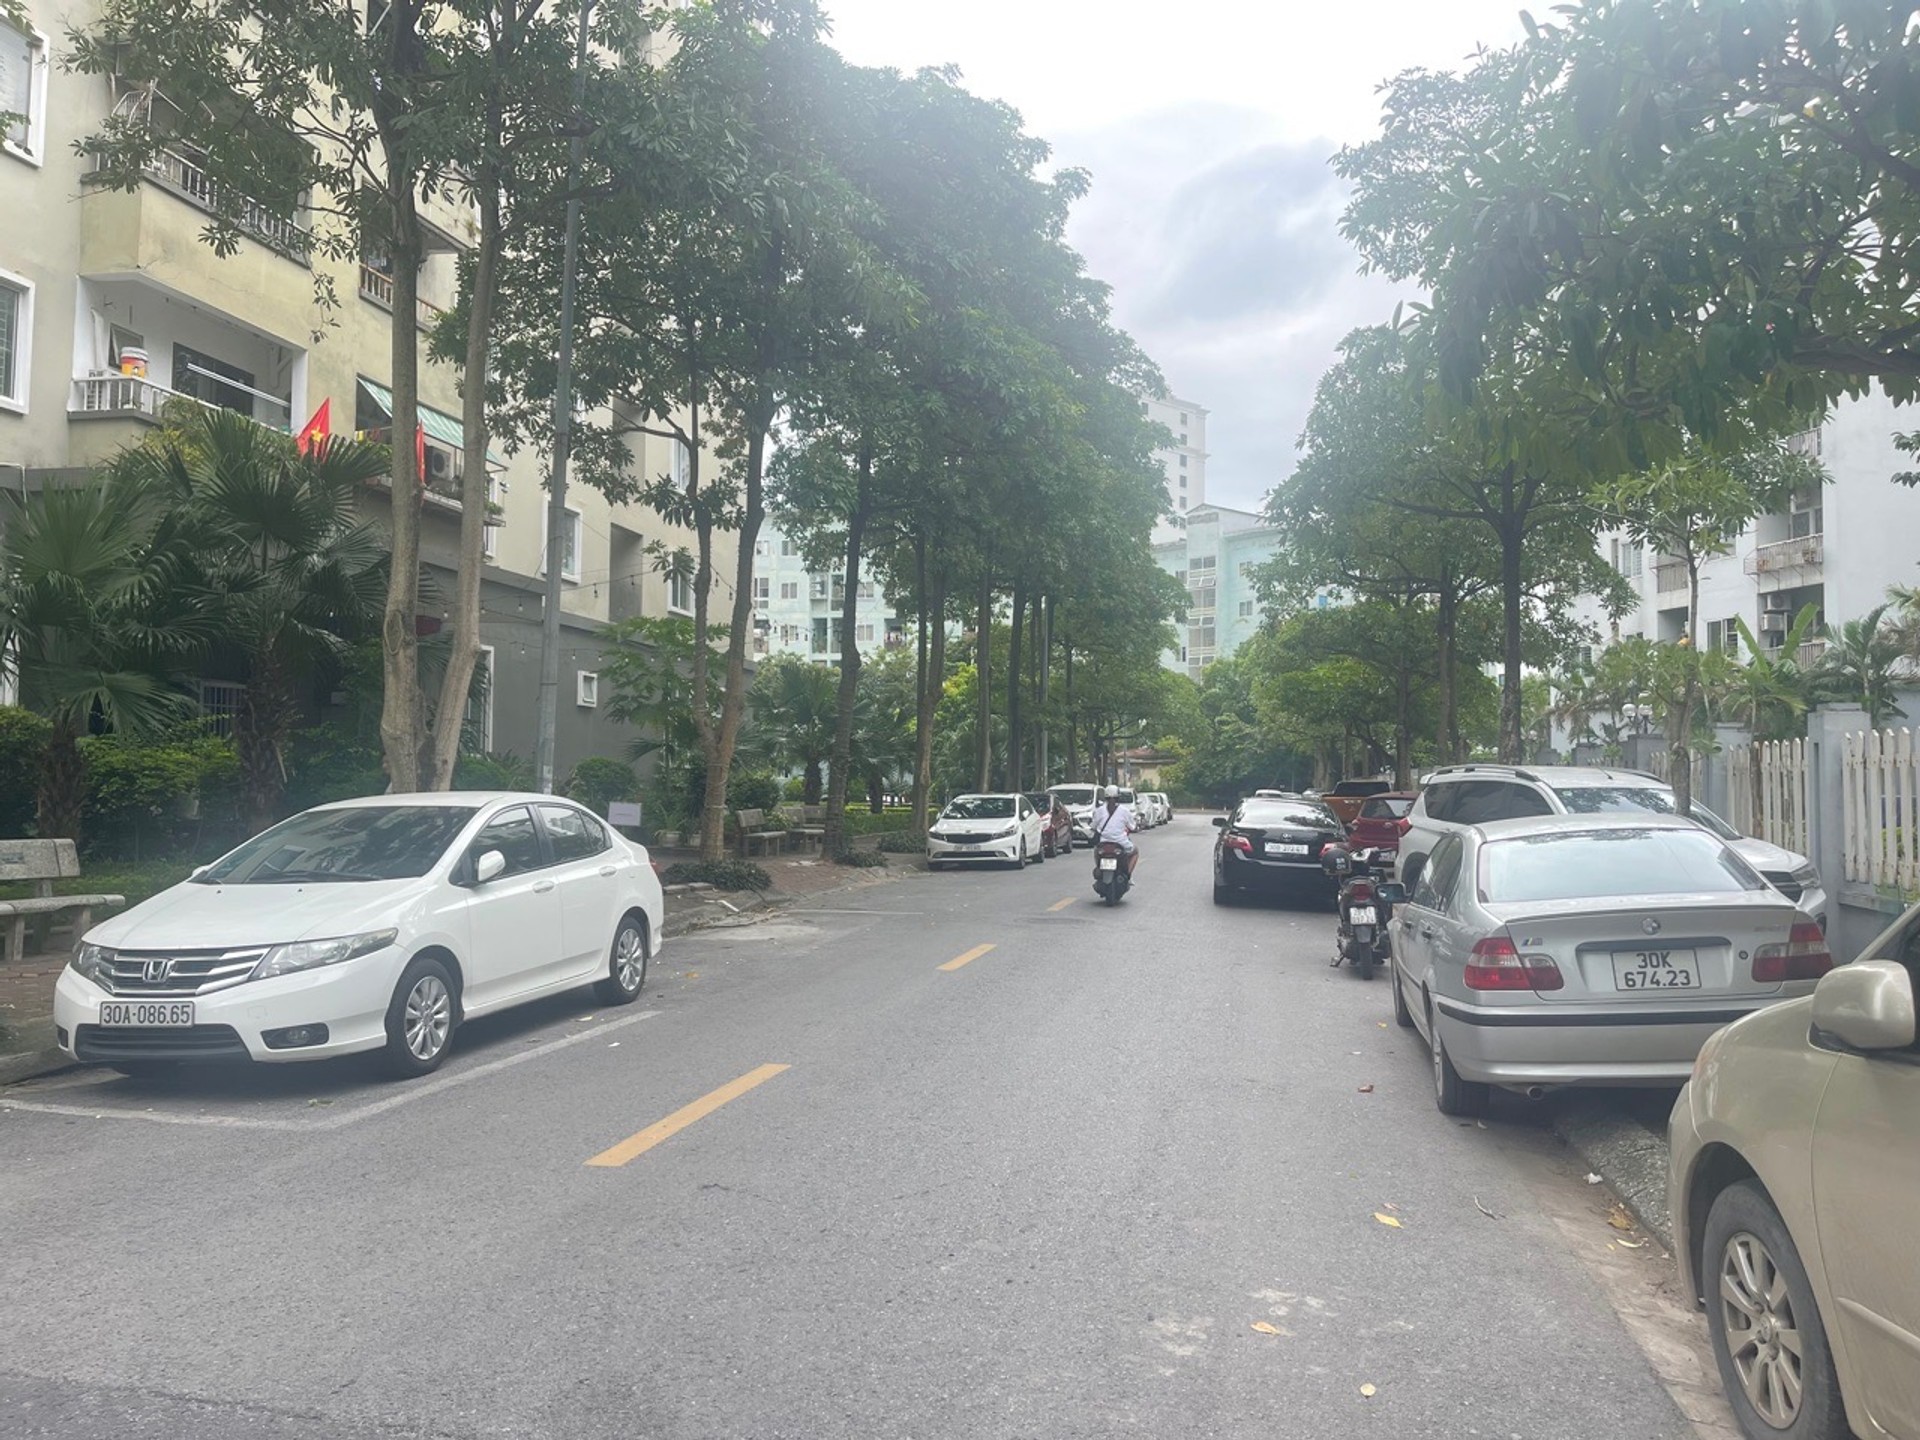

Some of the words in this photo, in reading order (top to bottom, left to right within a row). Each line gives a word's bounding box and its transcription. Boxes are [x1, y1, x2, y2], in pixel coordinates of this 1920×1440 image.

[1636, 951, 1672, 969] 30K
[1624, 969, 1691, 988] 674.23
[103, 1004, 190, 1024] 30A-086.65
